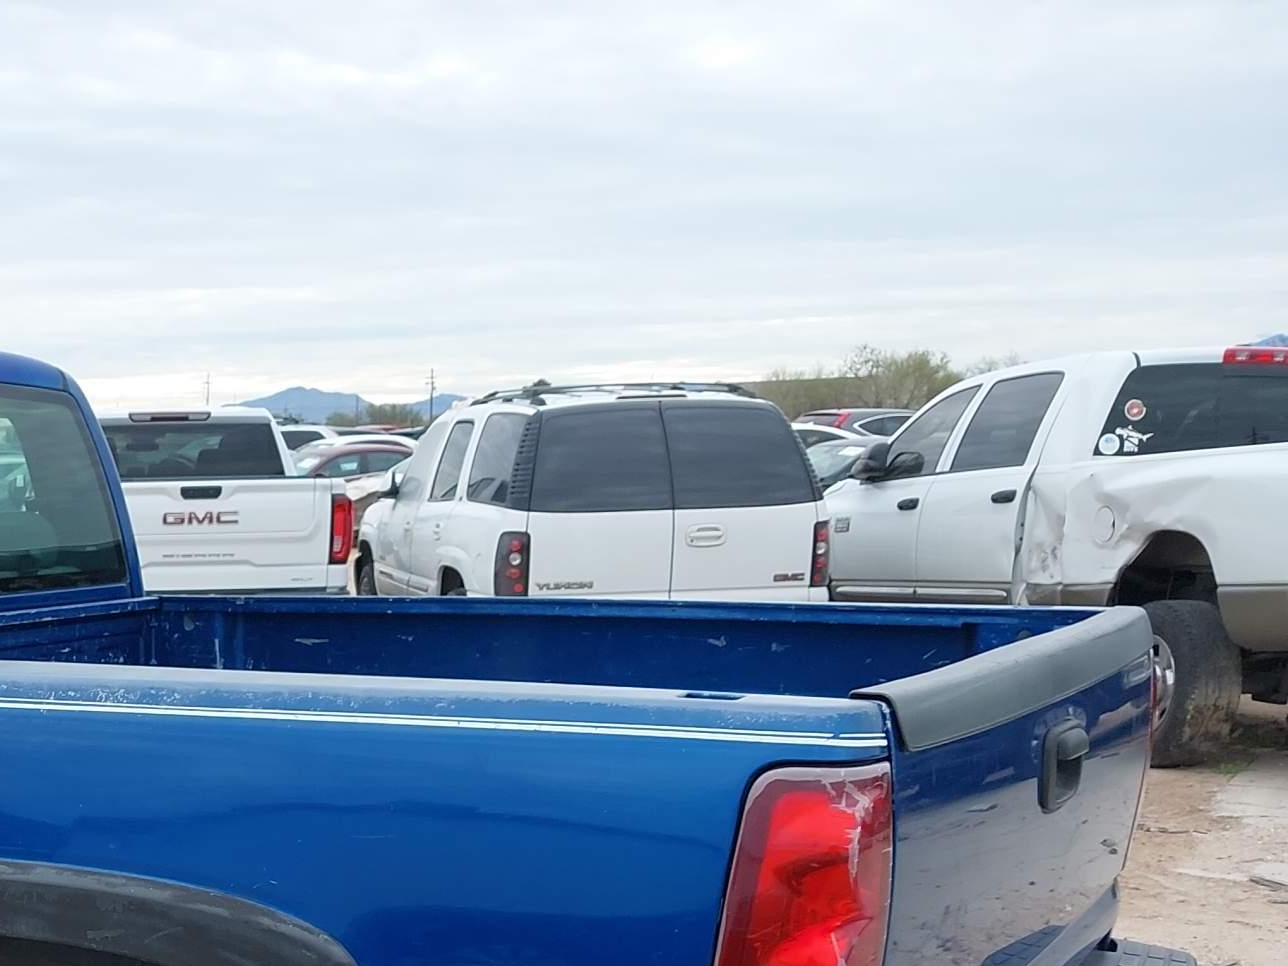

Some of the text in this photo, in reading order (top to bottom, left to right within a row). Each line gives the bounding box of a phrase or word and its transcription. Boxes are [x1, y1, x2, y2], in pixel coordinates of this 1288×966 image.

[162, 511, 239, 525] GMC
[772, 573, 805, 582] GMC
[535, 580, 594, 591] YUKON
